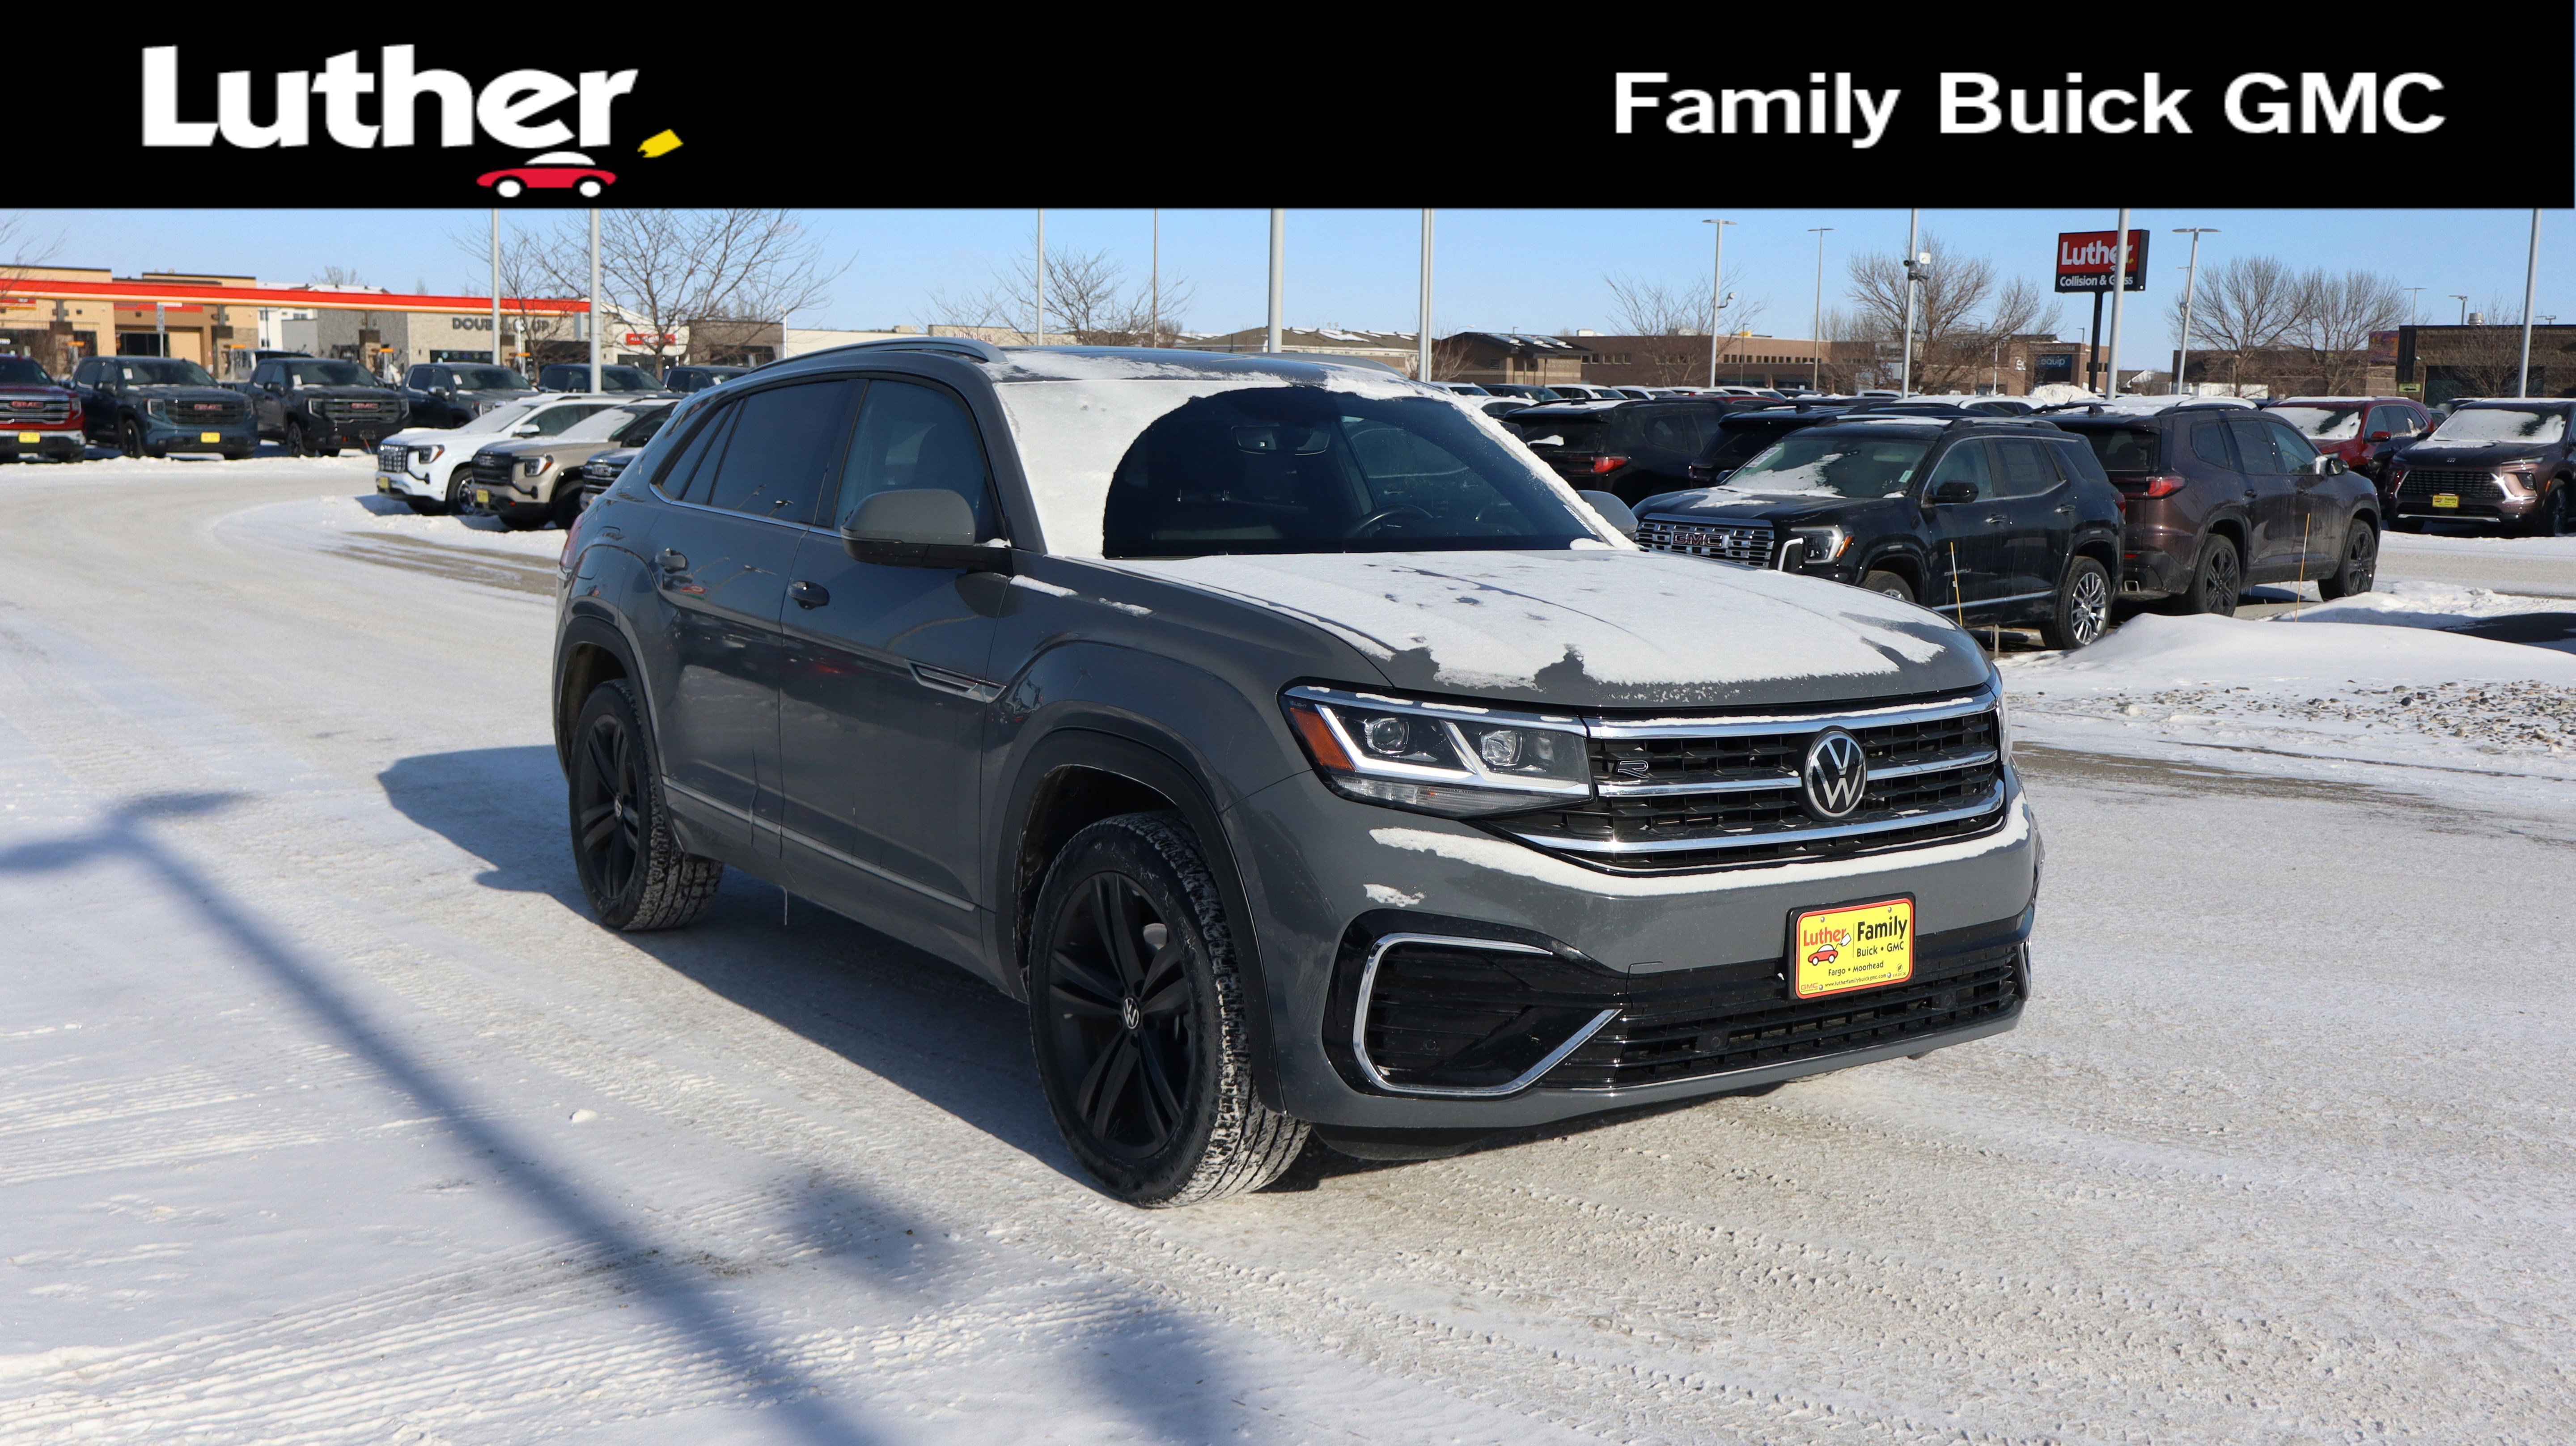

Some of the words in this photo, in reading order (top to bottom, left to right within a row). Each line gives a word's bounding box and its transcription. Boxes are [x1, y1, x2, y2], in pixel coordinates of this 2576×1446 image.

[2060, 276, 2097, 287] Collision
[2099, 275, 2107, 286] &
[2109, 275, 2133, 285] Gss
[453, 317, 493, 331] DOUB
[1674, 533, 1722, 547] GMC
[1618, 760, 1649, 778] R
[1804, 926, 1847, 946] Luther
[1857, 915, 1908, 942] Family
[1856, 945, 1878, 957] Buick
[1887, 941, 1904, 952] GMC
[1828, 967, 1846, 976] Fargo
[1852, 960, 1884, 973] Moorhead
[1801, 982, 1818, 990] GMC
[1825, 973, 1886, 987] www.lutherfamilybuickgmc.com
